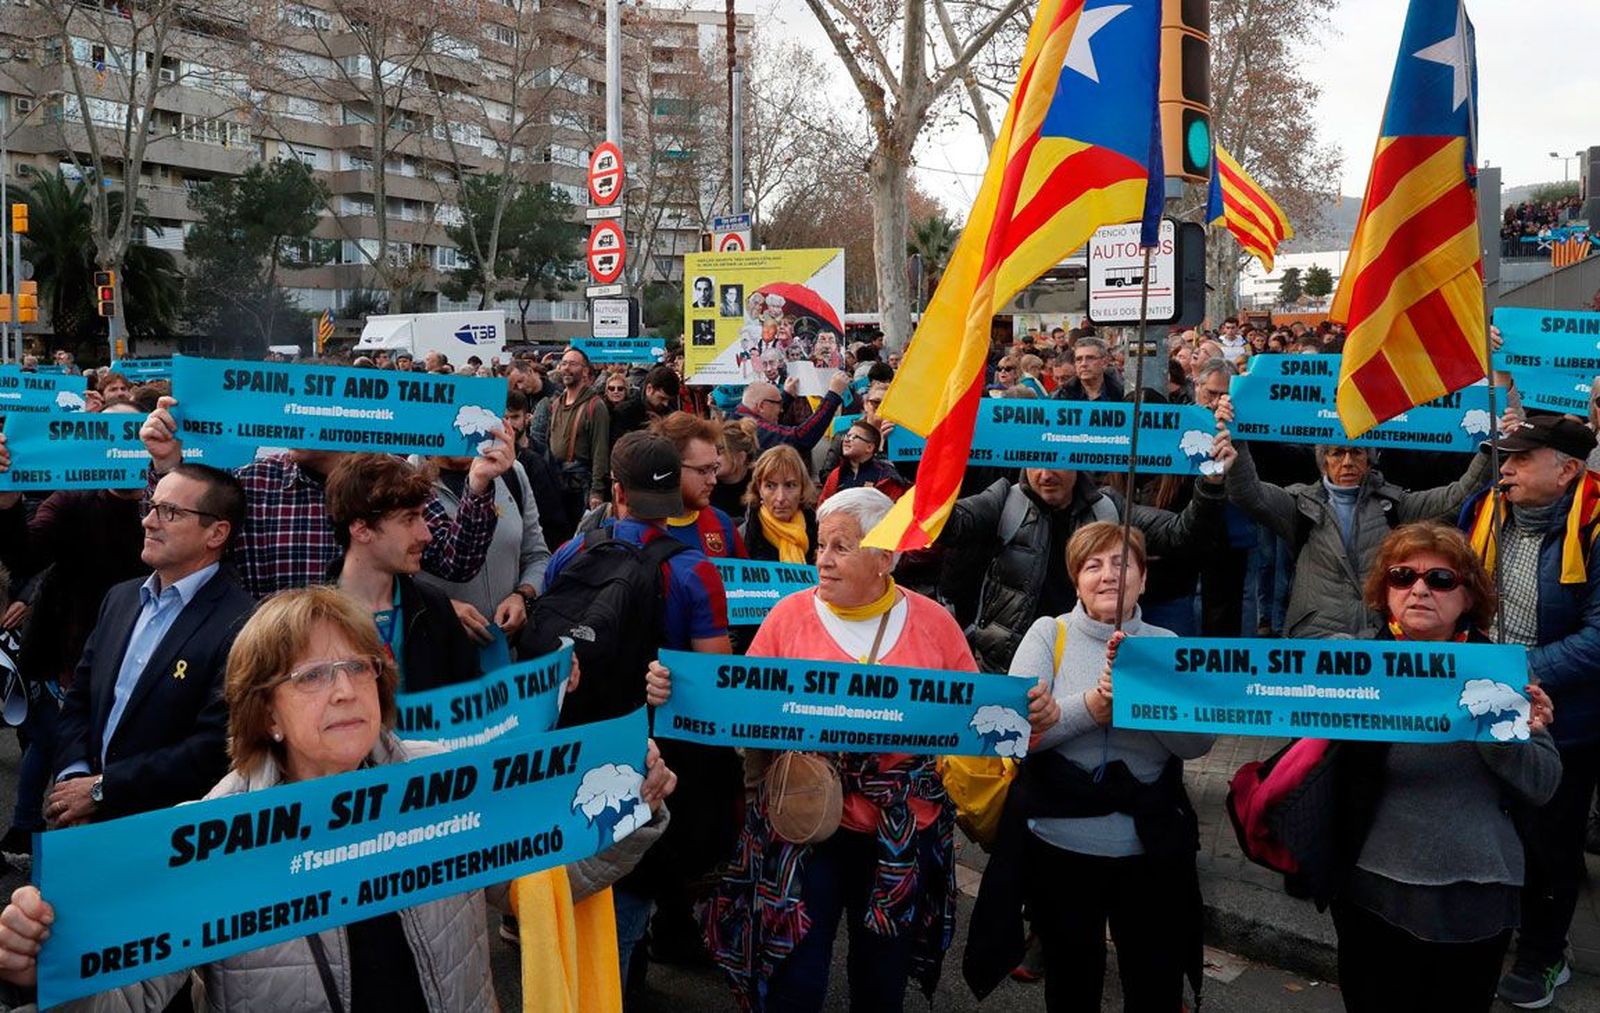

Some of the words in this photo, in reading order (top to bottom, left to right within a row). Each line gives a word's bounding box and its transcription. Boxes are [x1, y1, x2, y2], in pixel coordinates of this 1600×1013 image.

[1095, 227, 1126, 238] TENCIÓ
[1091, 309, 1102, 317] EN
[1104, 308, 1118, 316] ELS
[1120, 307, 1136, 315] DOS
[1139, 306, 1172, 315] NTITS
[472, 325, 496, 339] TSB
[1281, 361, 1332, 376] SPAIN,
[1505, 355, 1541, 367] DRETS
[24, 378, 56, 390] TALK!
[223, 369, 295, 396] SPAIN,
[303, 375, 336, 396] SIT
[343, 377, 389, 400] AND
[398, 380, 455, 404] TALK!
[1270, 384, 1326, 404] SPAIN,
[283, 403, 394, 420] #TsunamiDemocràtic
[993, 405, 1050, 427] SPAIN,
[1057, 408, 1083, 426] SIT
[1089, 409, 1126, 427] AND
[49, 421, 115, 443] SPAIN,
[123, 421, 145, 440] SI
[183, 419, 223, 435] DRETS
[237, 424, 305, 440] LLIBERTAT
[318, 429, 445, 447] AUTODETERMINACIÓ
[1237, 423, 1269, 435] DRETS
[1281, 425, 1334, 438] LLIBERTAT
[969, 448, 993, 460] RETS
[1004, 449, 1058, 463] LLIBERTAT
[1069, 453, 1172, 467] AUTODETERINACIÓ
[12, 470, 52, 483] DRETS
[65, 469, 126, 482] LLIBERTAT
[742, 566, 770, 583] AND
[775, 568, 815, 584] TALK!
[1174, 648, 1257, 675] SPAIN,
[1268, 649, 1306, 674] SIT
[1316, 650, 1372, 676] AND
[1383, 651, 1456, 679] TALK!
[716, 664, 793, 694] SPAIN,
[803, 669, 840, 694] SIT
[848, 673, 899, 699] AND
[909, 677, 974, 705] TALK!
[1246, 683, 1380, 701] #TsunamiDemocràtic
[396, 703, 440, 731] AIN,
[450, 693, 483, 724] SIT
[485, 683, 509, 715] AND
[515, 662, 560, 701] TALK!
[782, 701, 903, 723] #TsunamiDemocràtic
[1131, 703, 1177, 721] DRETS
[1194, 707, 1273, 726] LLIBERTAT
[1290, 711, 1450, 733] AUTODETERMINACIÓ
[672, 714, 716, 735] DRETS
[731, 722, 804, 742] LLIBERTAT
[820, 729, 959, 748] AUTODETERMINACIÓ
[168, 799, 311, 868] SPAIN,
[328, 785, 388, 830] SIT
[400, 767, 478, 813] AND
[493, 741, 582, 790] TALK!
[289, 811, 481, 875] #TsunamiDemocràtic
[80, 933, 171, 979] DRETS
[202, 890, 332, 948] LLIBERTAT
[357, 826, 564, 906] AUTODETERMINACIÓ
